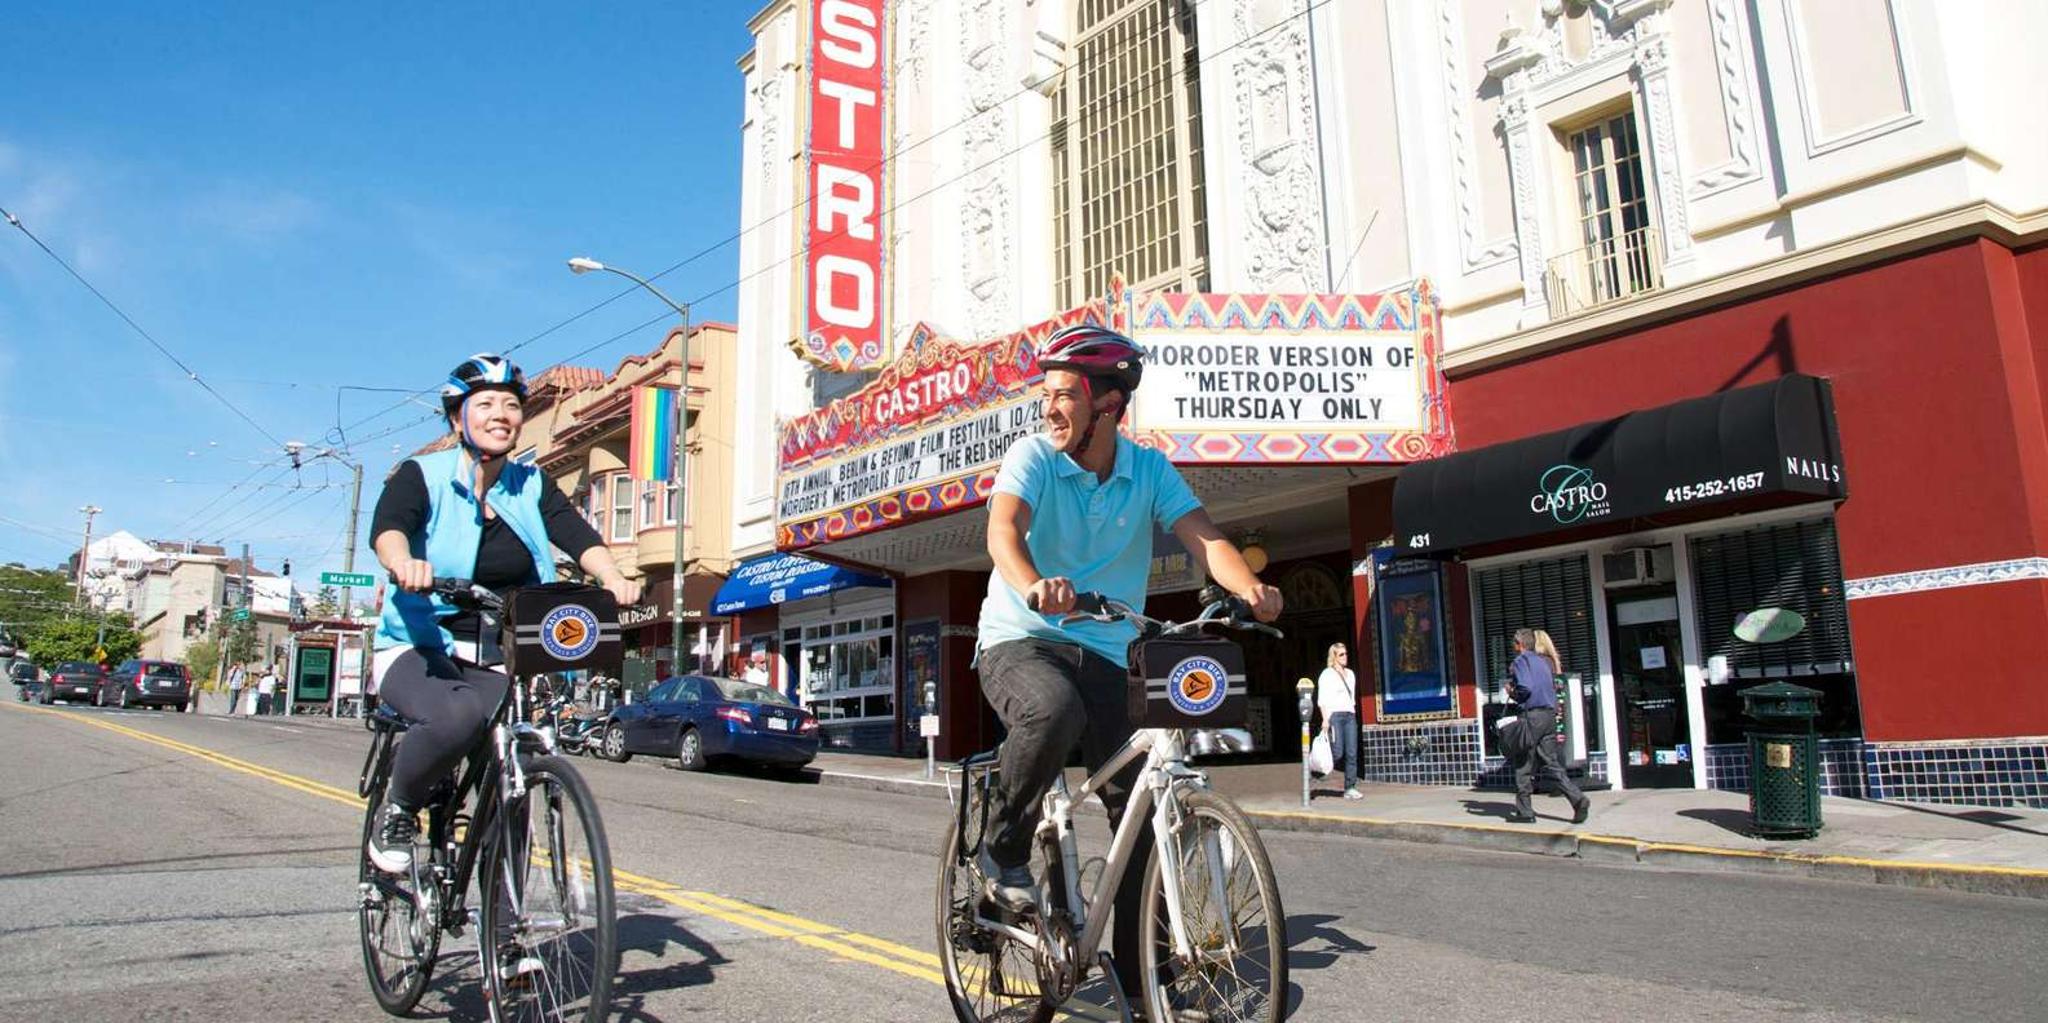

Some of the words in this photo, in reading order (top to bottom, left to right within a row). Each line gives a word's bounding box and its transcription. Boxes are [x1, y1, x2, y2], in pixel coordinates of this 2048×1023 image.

[1141, 344, 1260, 366] MORODER
[1268, 345, 1373, 367] VERSION
[1386, 346, 1415, 367] OF
[876, 362, 970, 423] CASTRO
[1174, 396, 1303, 420] THURSDAY
[1322, 398, 1382, 420] ONLY
[803, 466, 833, 491] ANNUAL
[839, 454, 869, 481] BERLIN
[870, 452, 878, 471] &
[881, 441, 915, 467] BEYOND
[920, 431, 945, 456] FILM
[949, 413, 1001, 447] FESTIVAL
[938, 449, 961, 472] THE
[965, 441, 986, 466] RED
[1785, 456, 1841, 483] NAILS
[780, 490, 828, 518] MORODER'S
[833, 468, 890, 503] METROPOLIS
[1530, 482, 1607, 513] CASTRO
[1664, 471, 1765, 503] 415-252-1657
[1586, 508, 1611, 518] SALON
[1591, 501, 1610, 510] NAIL
[1409, 533, 1431, 548] 431
[330, 575, 366, 585] Market
[736, 560, 776, 579] CASTRO
[545, 613, 559, 630] BAY
[580, 611, 595, 628] BIKE
[630, 604, 658, 623] DESIGN
[1172, 668, 1186, 683] BAY
[1186, 660, 1207, 669] CITY
[1207, 663, 1223, 681] BIKE
